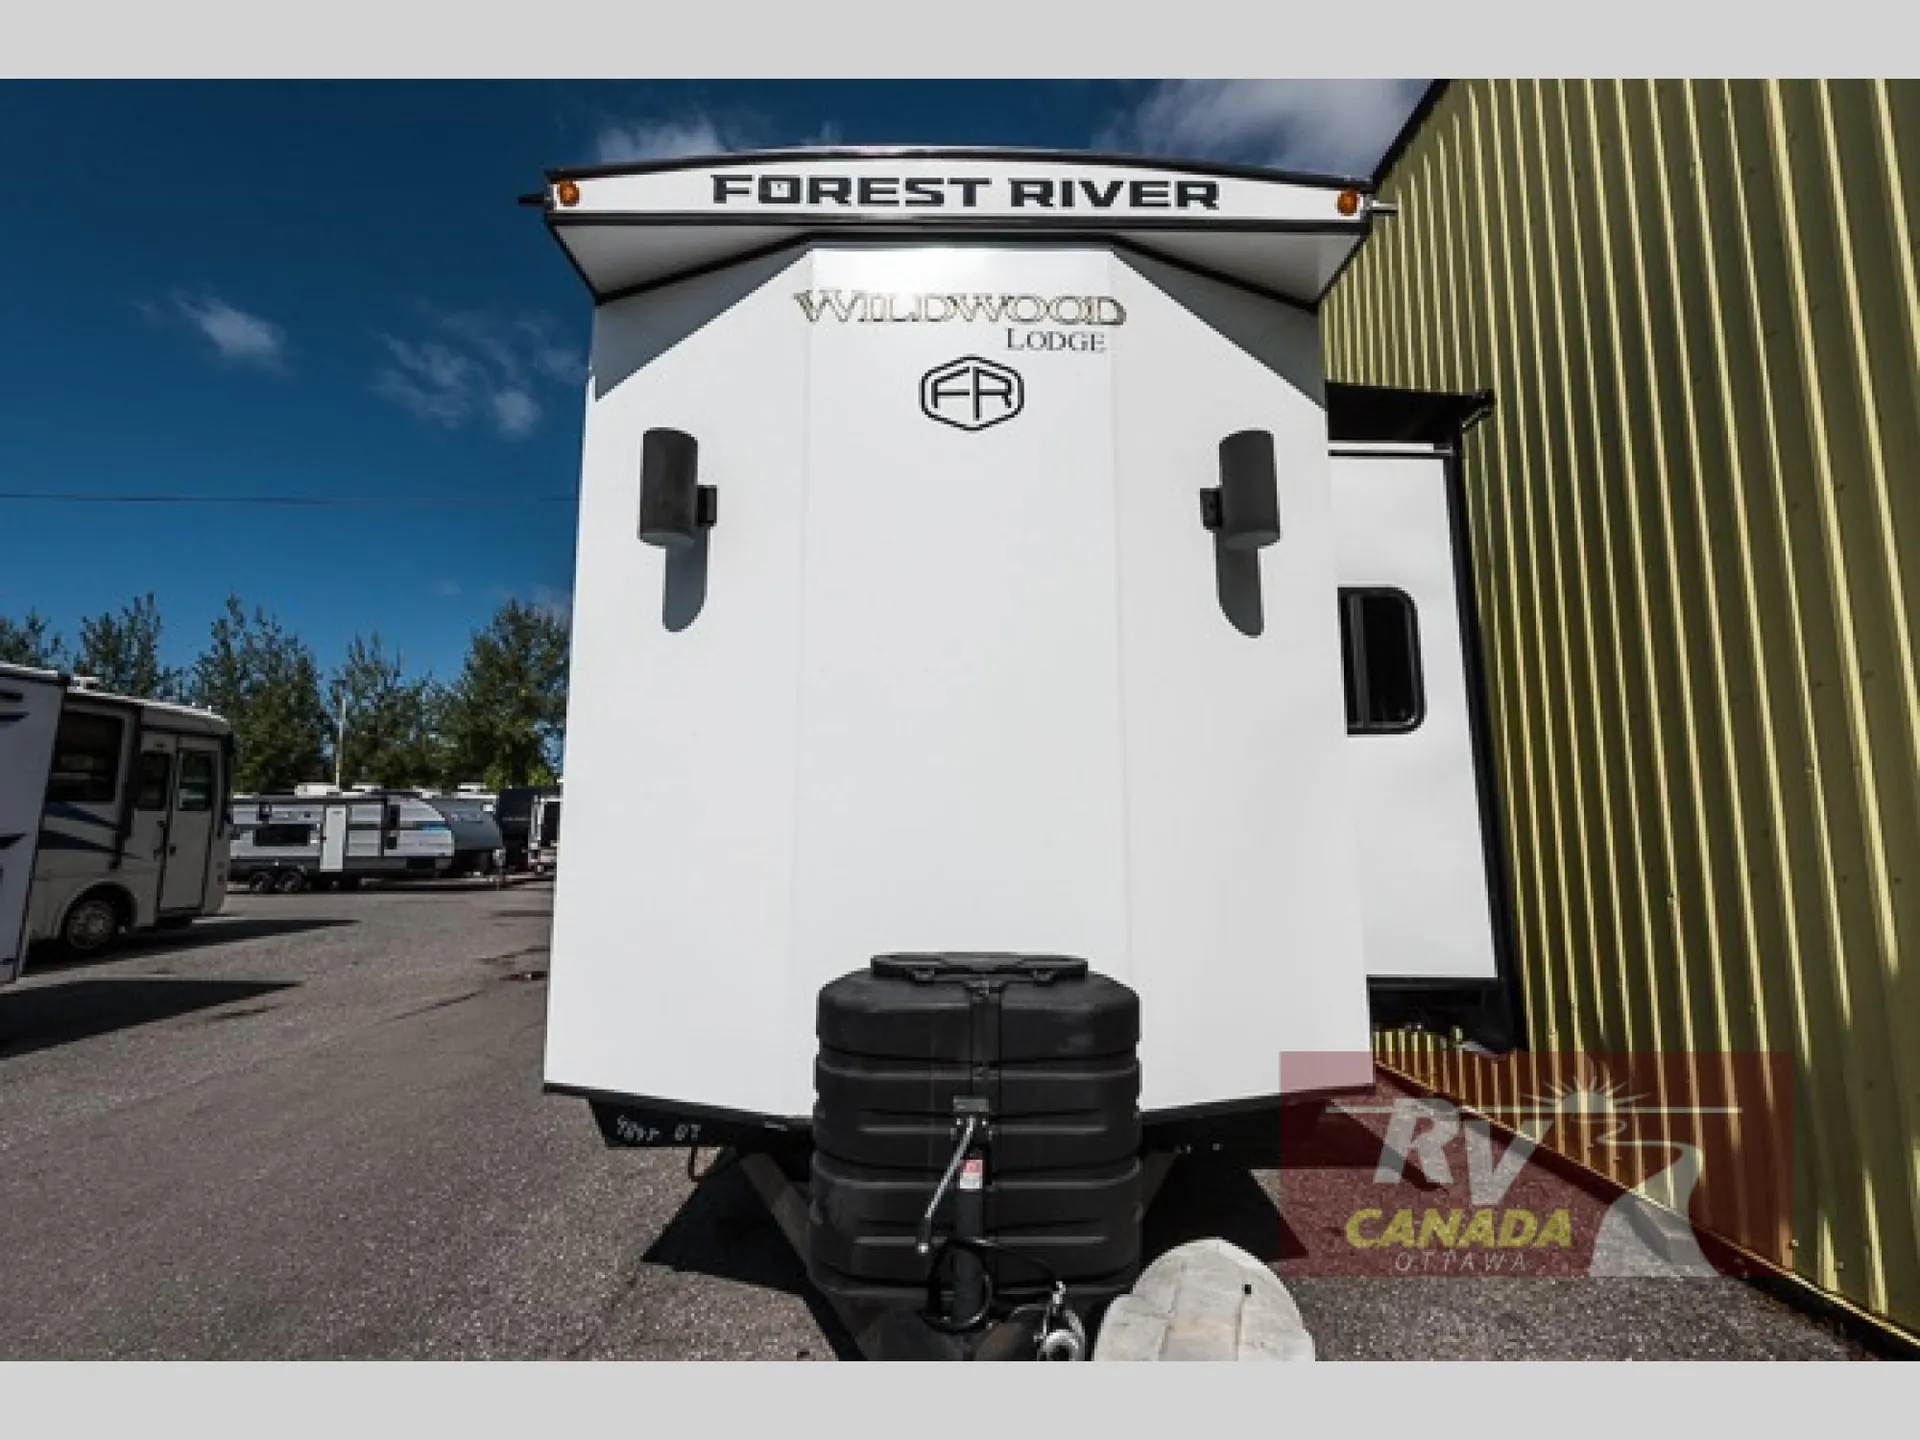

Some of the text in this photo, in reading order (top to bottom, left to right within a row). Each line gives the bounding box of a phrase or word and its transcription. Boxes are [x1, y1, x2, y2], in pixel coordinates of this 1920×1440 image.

[710, 174, 1219, 211] FOREST RIVER
[793, 289, 1127, 326] WILDWOOD
[1007, 327, 1107, 352] LODGE
